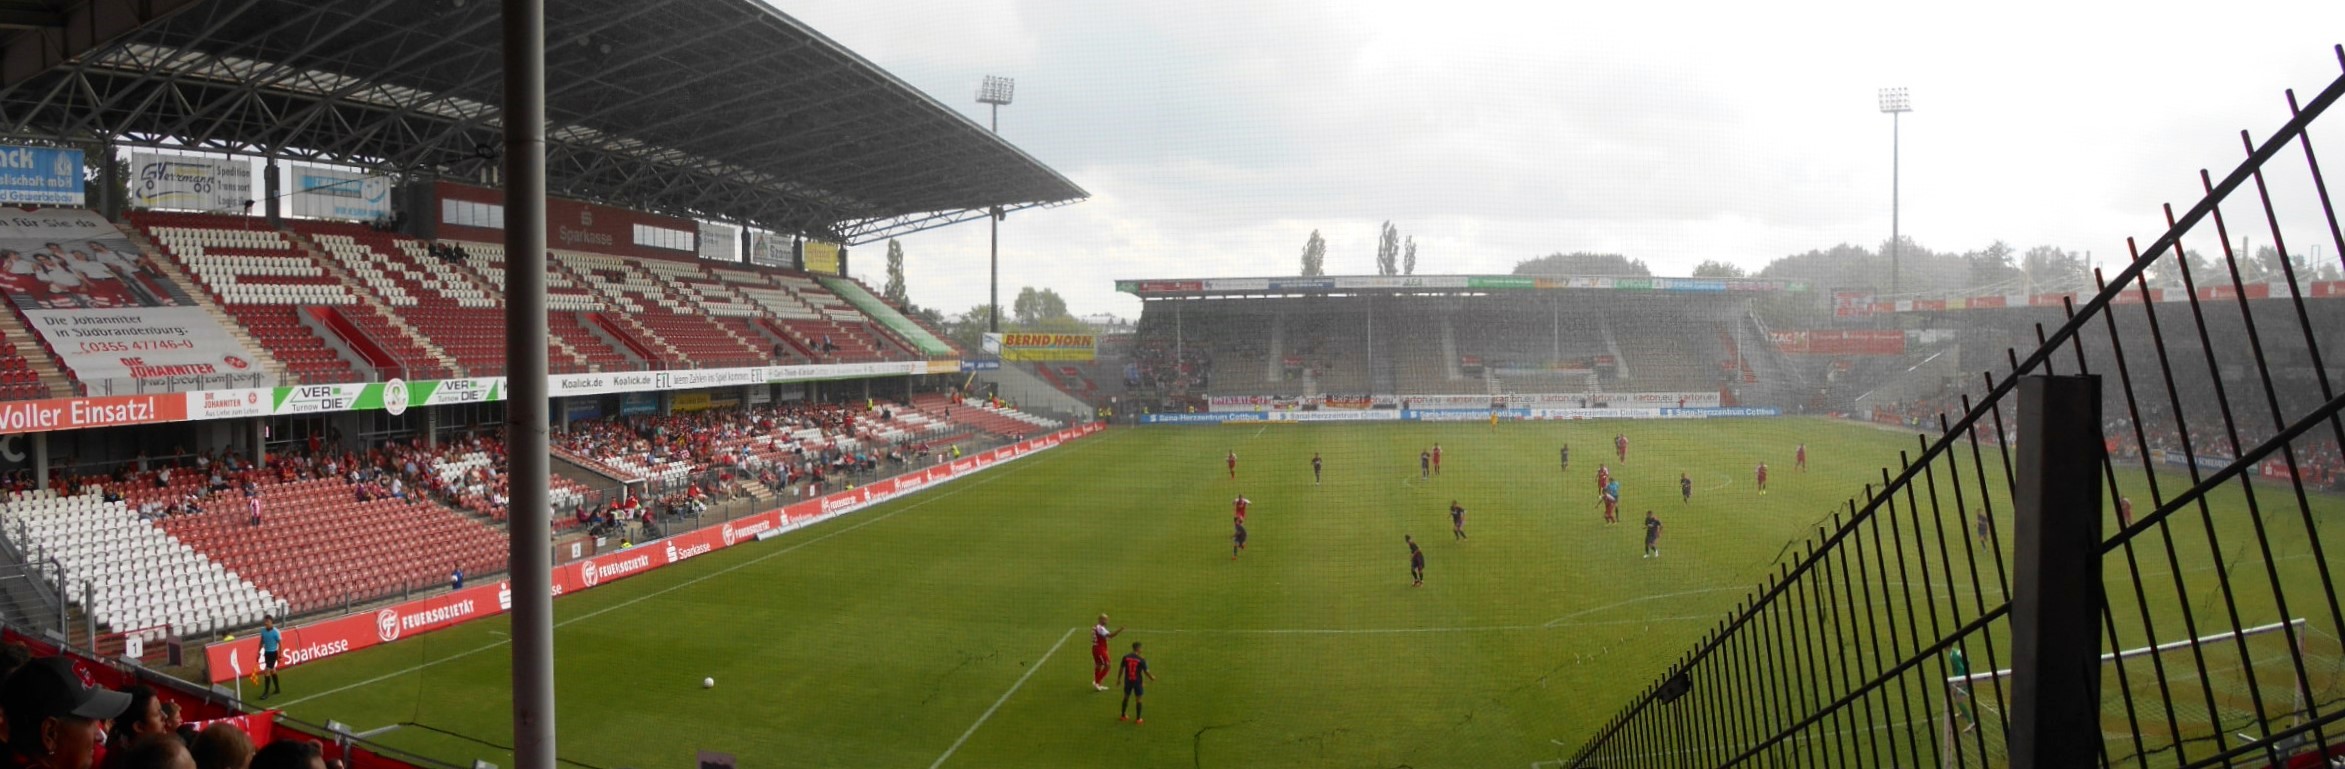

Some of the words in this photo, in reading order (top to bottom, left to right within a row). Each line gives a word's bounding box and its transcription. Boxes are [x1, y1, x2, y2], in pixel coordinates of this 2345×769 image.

[559, 226, 613, 246] Sparkasse
[44, 316, 69, 326] Die
[73, 316, 142, 326] Johanniter
[55, 328, 70, 338] in
[75, 326, 188, 338] Südbrandenburg:
[90, 340, 128, 352] 0355
[1005, 335, 1051, 346] BERND
[1055, 335, 1092, 346] HORN
[130, 363, 216, 379] JOHANNITER
[446, 380, 470, 390] VER
[562, 379, 603, 389] Koalick.de
[614, 376, 651, 387] Koalick.de
[204, 393, 215, 401] DIE
[301, 386, 331, 398] VER
[461, 390, 484, 401] DIE
[204, 399, 241, 409] JOHANNITER
[292, 403, 318, 412] Turnow
[321, 398, 343, 410] DIE
[0, 401, 62, 430] Voller
[71, 396, 155, 425] Einsatz!
[678, 541, 711, 561] Sparkasse
[599, 555, 649, 579] FEUERSOZIETÄT
[402, 598, 475, 630] FEUERSOZIETÄT
[131, 642, 138, 655] 1
[283, 638, 349, 666] Sparkasse
